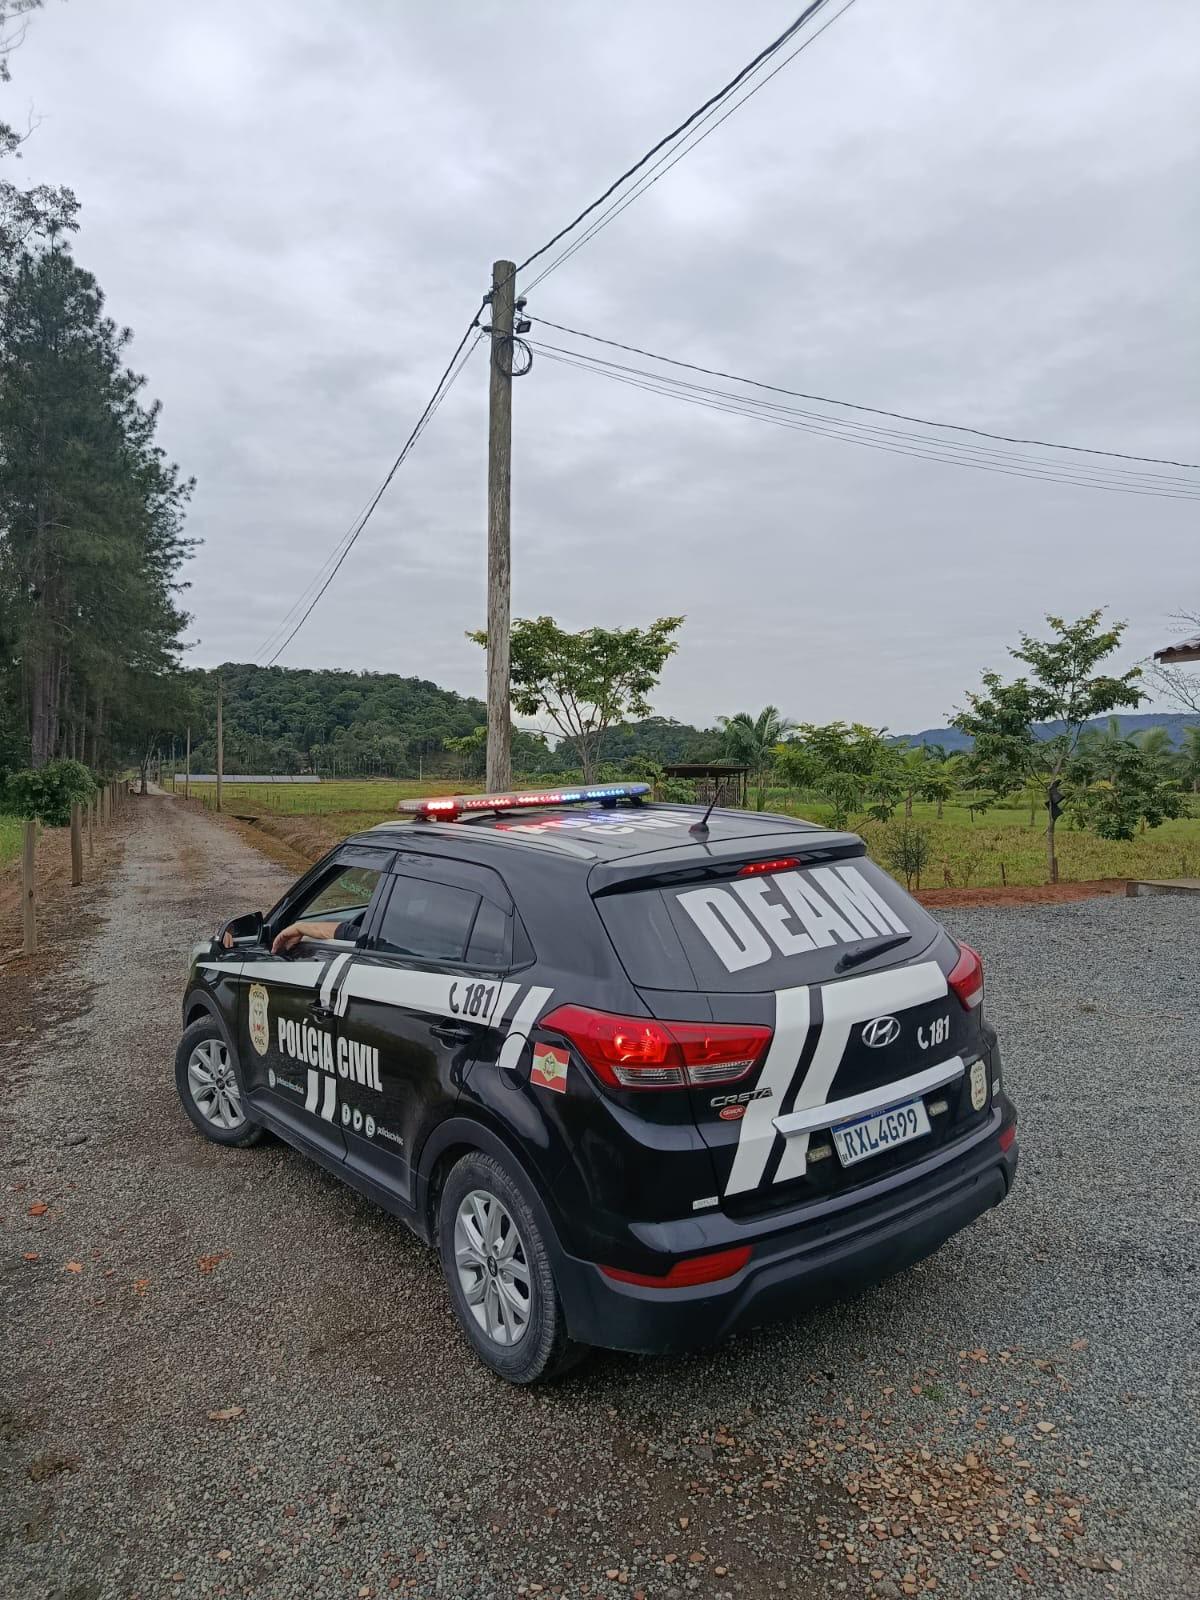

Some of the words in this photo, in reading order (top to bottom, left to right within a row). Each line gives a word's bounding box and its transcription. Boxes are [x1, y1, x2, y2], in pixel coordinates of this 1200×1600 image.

[675, 865, 912, 974] DEAM
[462, 983, 496, 1019] 181
[929, 1014, 950, 1047] 181
[277, 1017, 336, 1074] POLÍCIA
[336, 1036, 384, 1093] CIVIL
[710, 1087, 774, 1108] CRETA
[843, 1108, 918, 1159] RXL4G99
